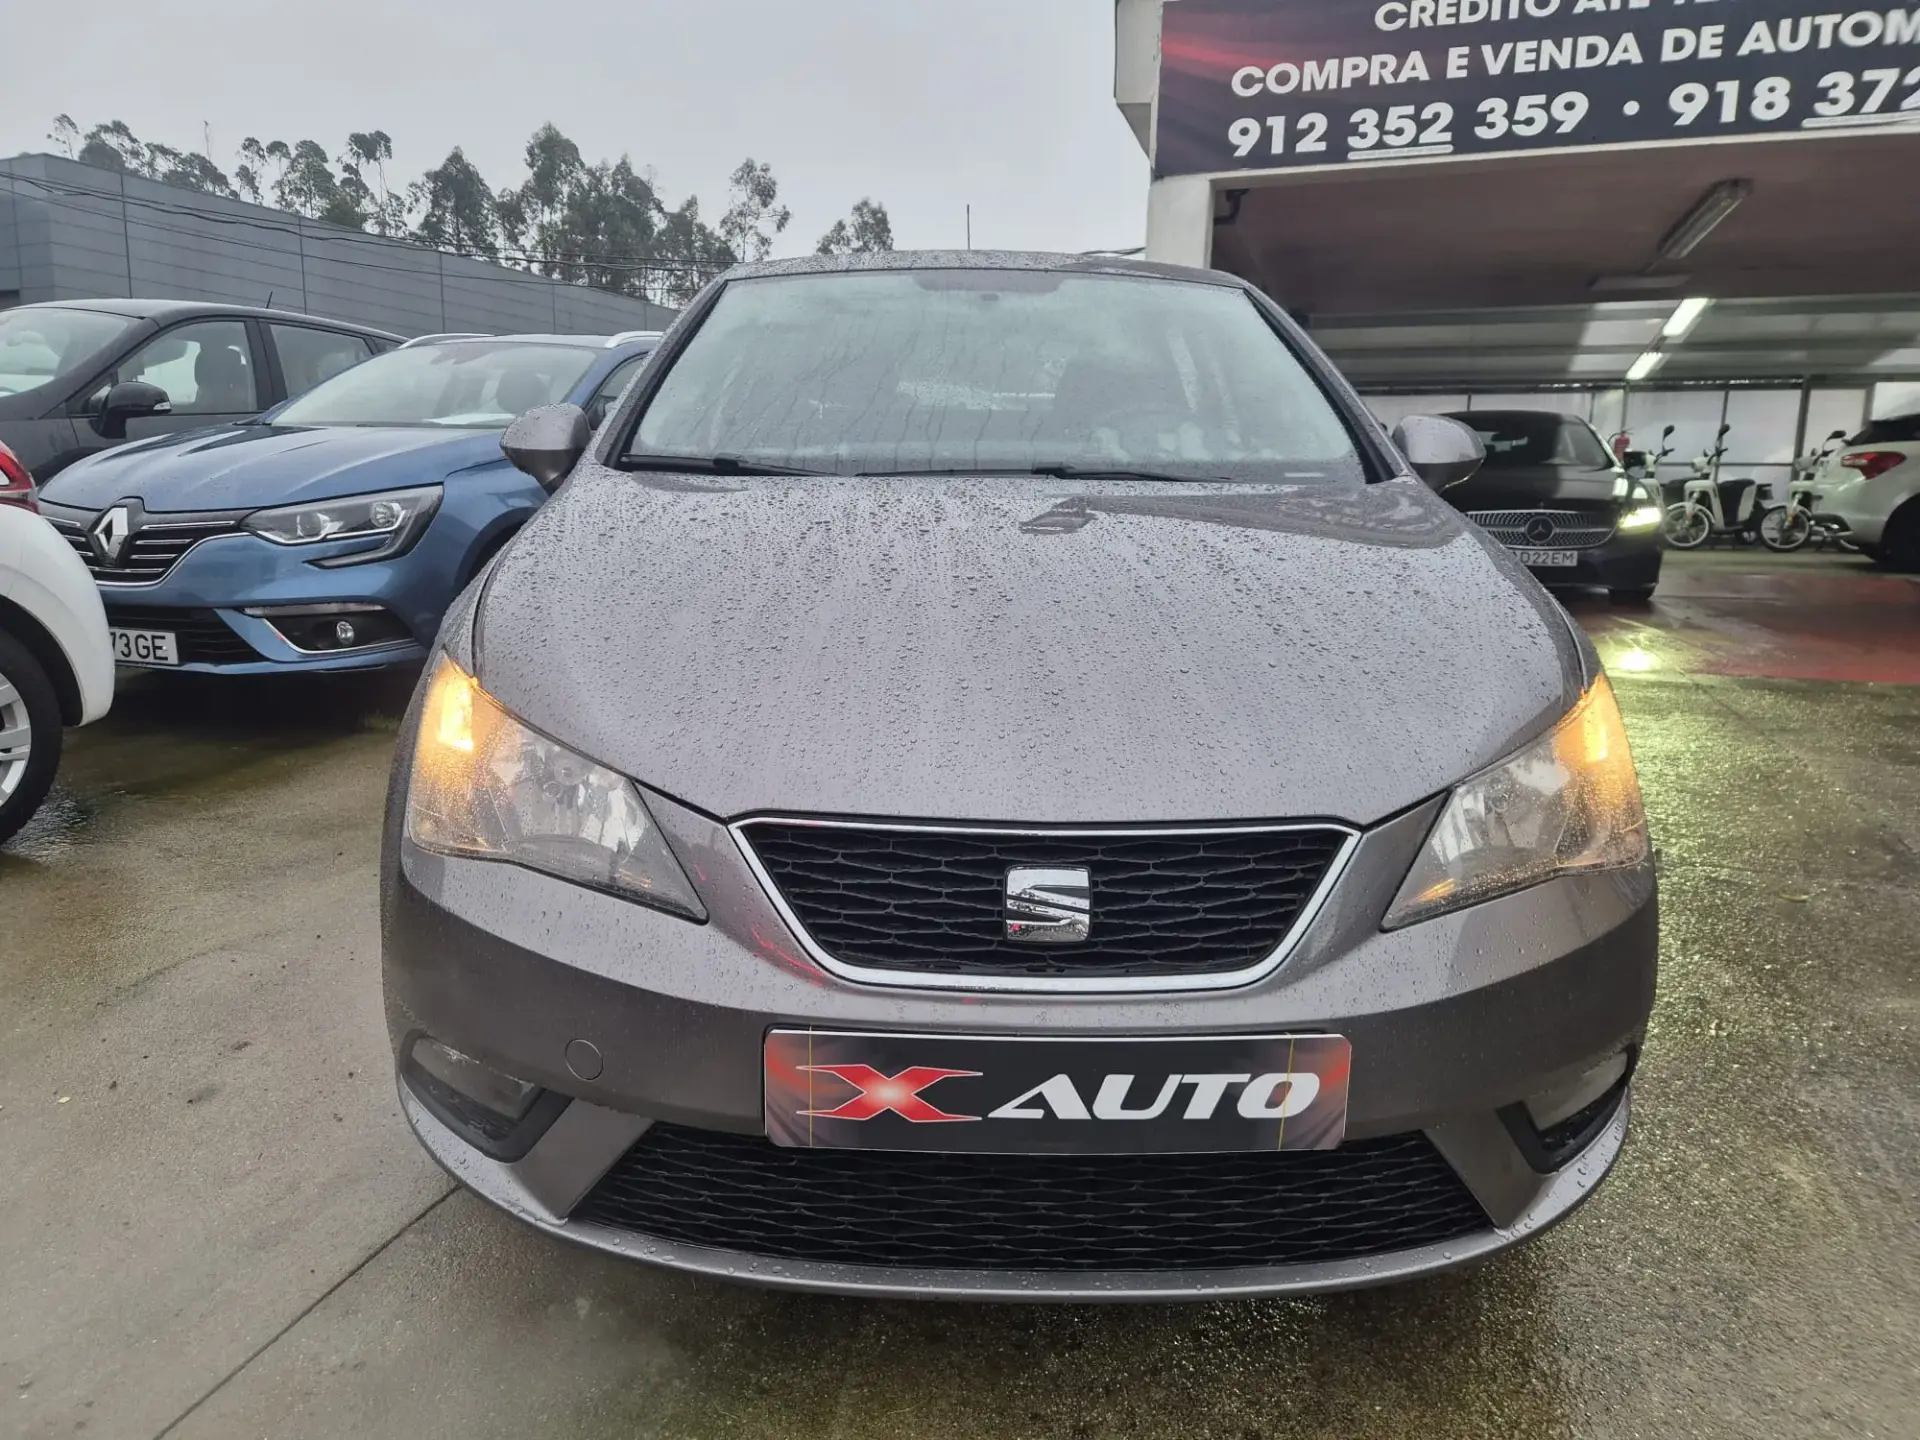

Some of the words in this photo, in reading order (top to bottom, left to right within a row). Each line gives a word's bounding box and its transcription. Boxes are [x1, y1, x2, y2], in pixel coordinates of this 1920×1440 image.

[1231, 51, 1430, 97] COMPRA
[1446, 46, 1470, 79] E
[1481, 32, 1644, 75] VENDA
[1660, 24, 1725, 63] DE
[1736, 8, 1920, 56] AUTOM
[1228, 112, 1328, 157] 912
[1347, 102, 1454, 149] 352
[1474, 91, 1590, 140] 359
[1668, 76, 1791, 126] 918
[1512, 551, 1575, 565] O22EM
[988, 1073, 1321, 1120] AUTO
